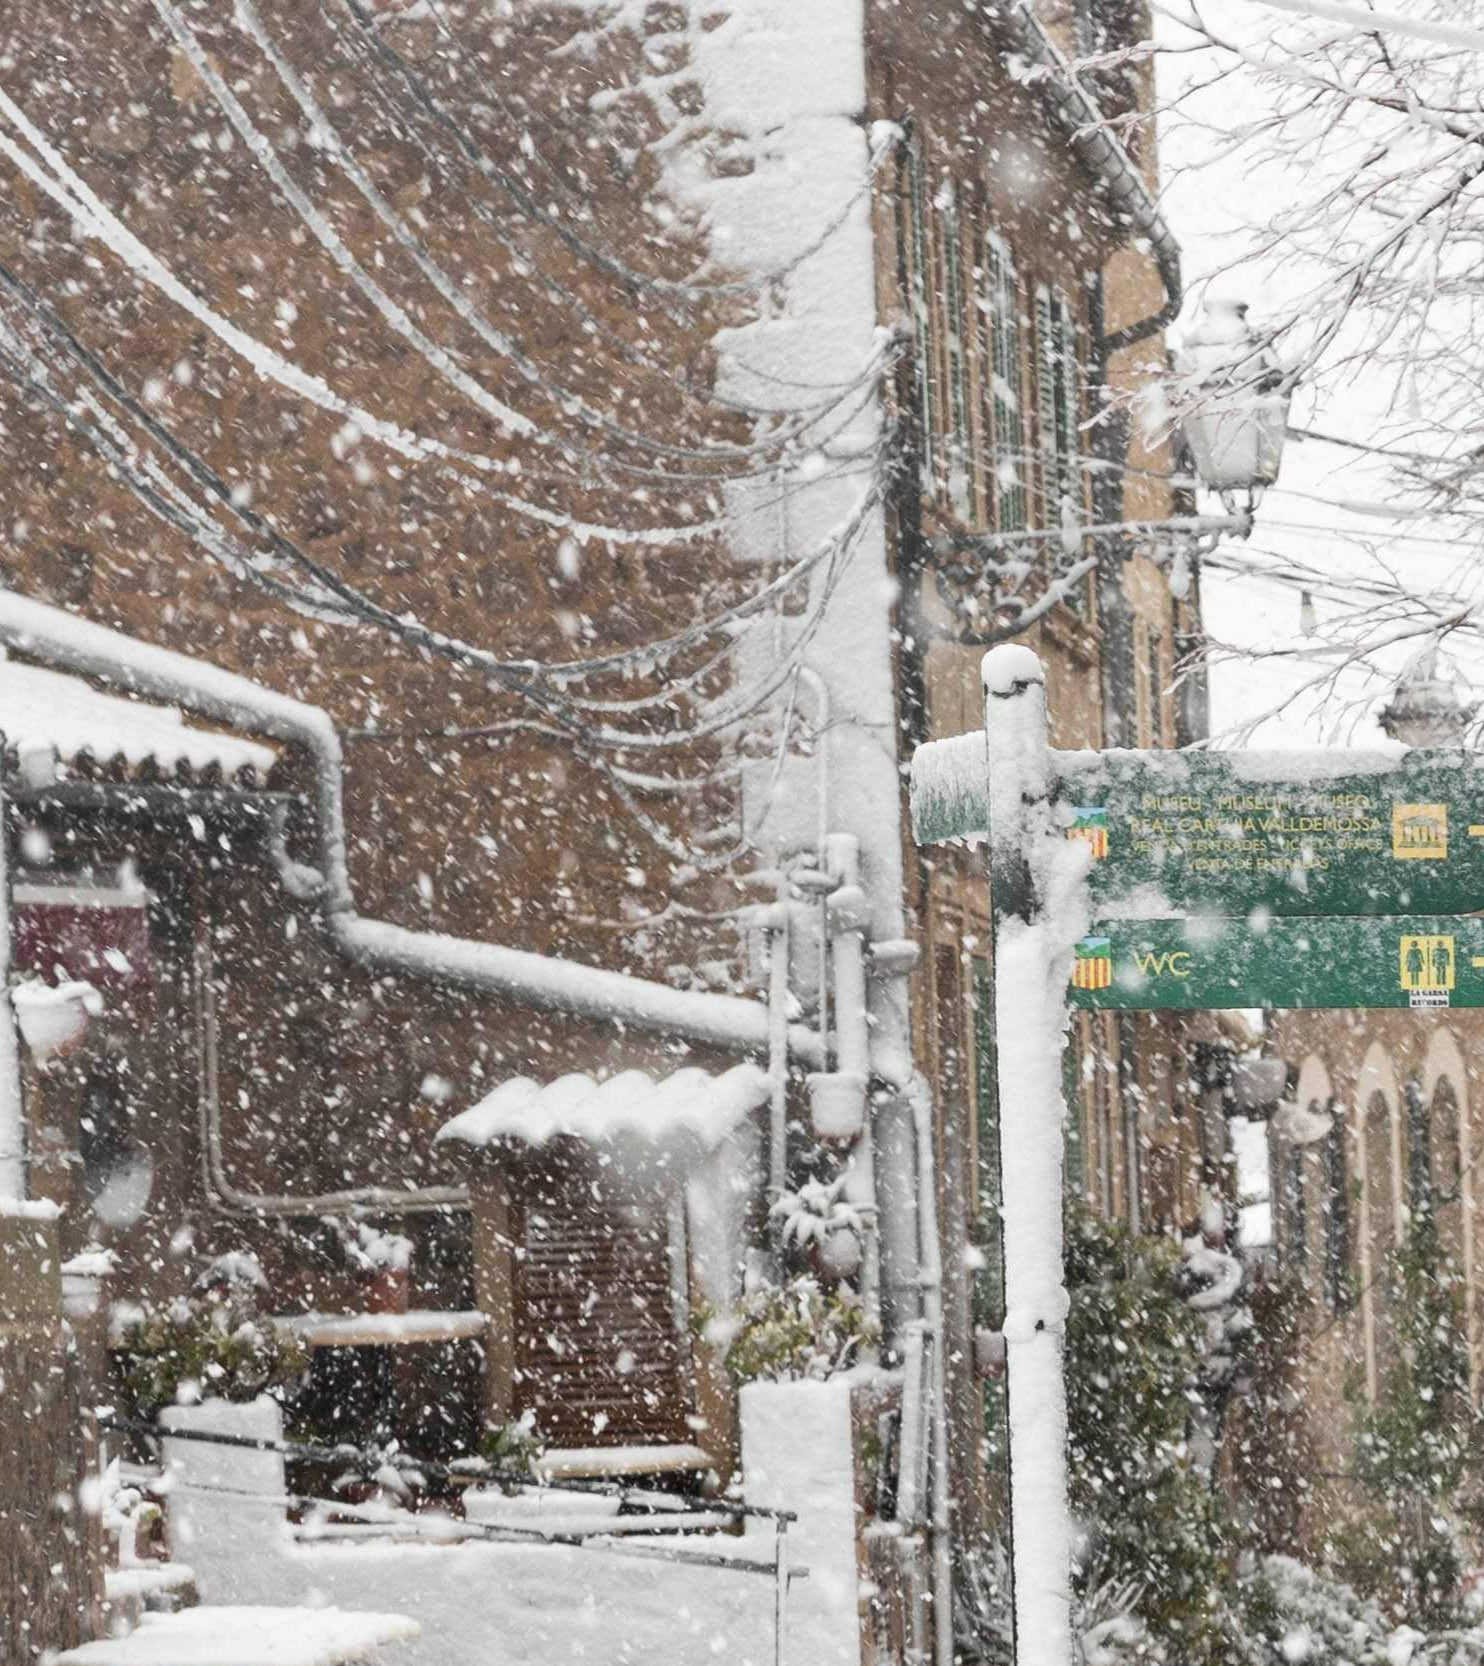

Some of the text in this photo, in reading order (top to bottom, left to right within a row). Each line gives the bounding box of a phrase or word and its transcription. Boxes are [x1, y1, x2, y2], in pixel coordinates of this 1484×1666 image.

[1130, 817, 1173, 833] REAL
[1257, 816, 1381, 832] VALLDEMOSSA
[1132, 950, 1191, 976] WC
